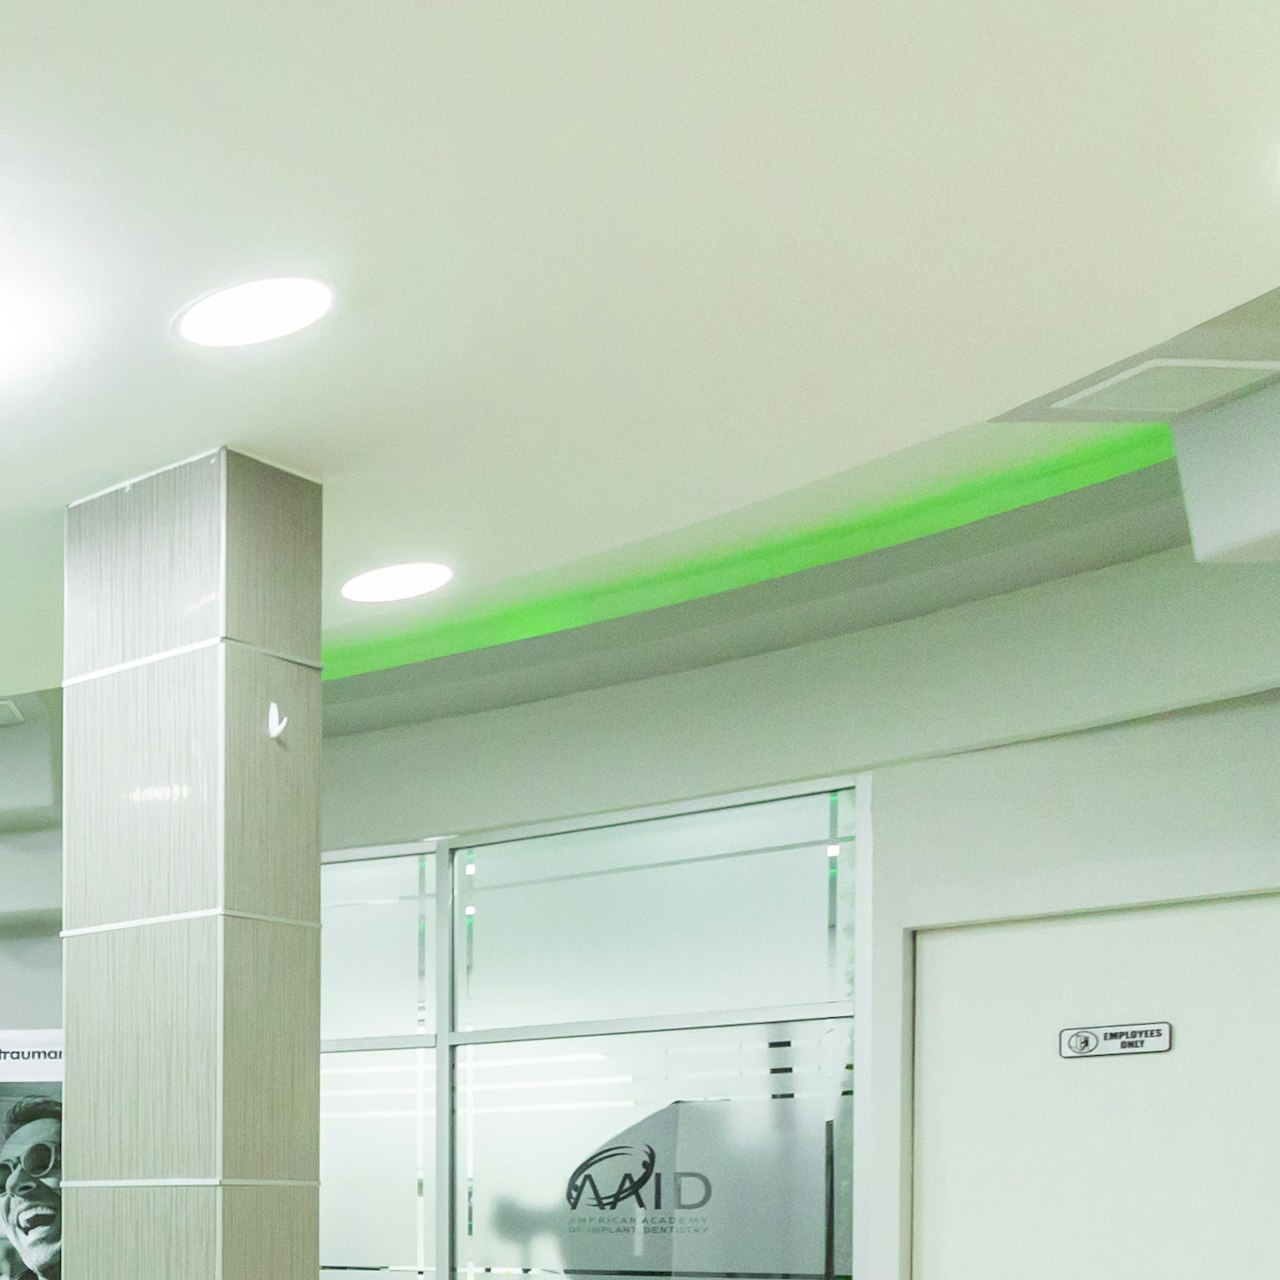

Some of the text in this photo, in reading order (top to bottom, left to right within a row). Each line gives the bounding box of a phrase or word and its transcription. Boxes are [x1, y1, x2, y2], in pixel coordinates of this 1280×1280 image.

[1103, 1029, 1163, 1041] EMPLOYEES
[1120, 1040, 1145, 1050] ONLY
[569, 1172, 712, 1210] AAID
[567, 1216, 708, 1225] AMERICAN ACADEMY
[587, 1226, 636, 1234] IMPLANT
[643, 1226, 710, 1234] DENTISTRY
